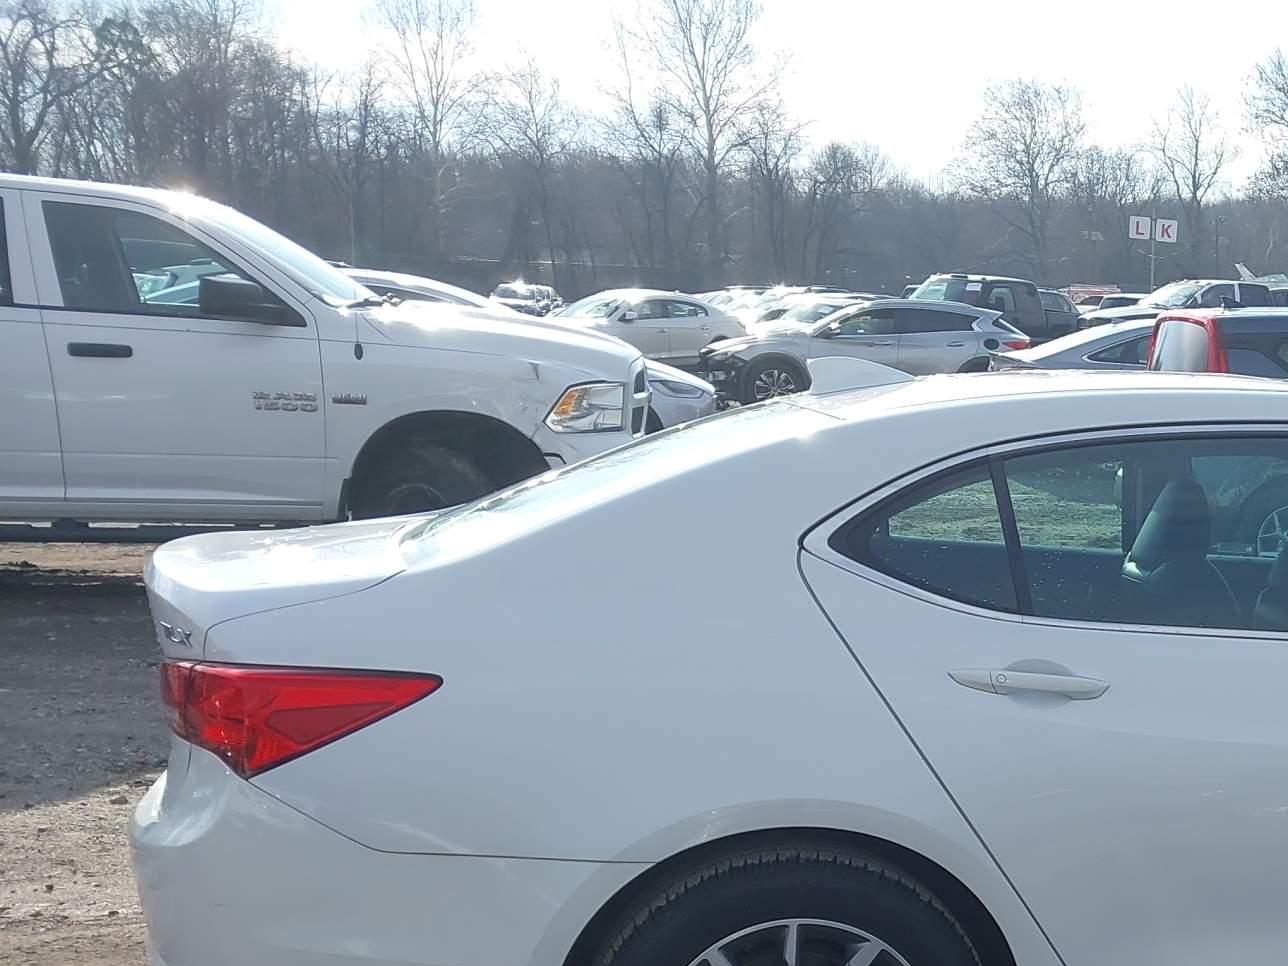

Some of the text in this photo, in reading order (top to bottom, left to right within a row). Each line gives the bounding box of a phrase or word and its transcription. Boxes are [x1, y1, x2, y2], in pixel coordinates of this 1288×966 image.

[1135, 220, 1145, 236] L
[1160, 223, 1173, 239] K
[252, 391, 318, 402] RAM
[255, 400, 319, 413] 1500
